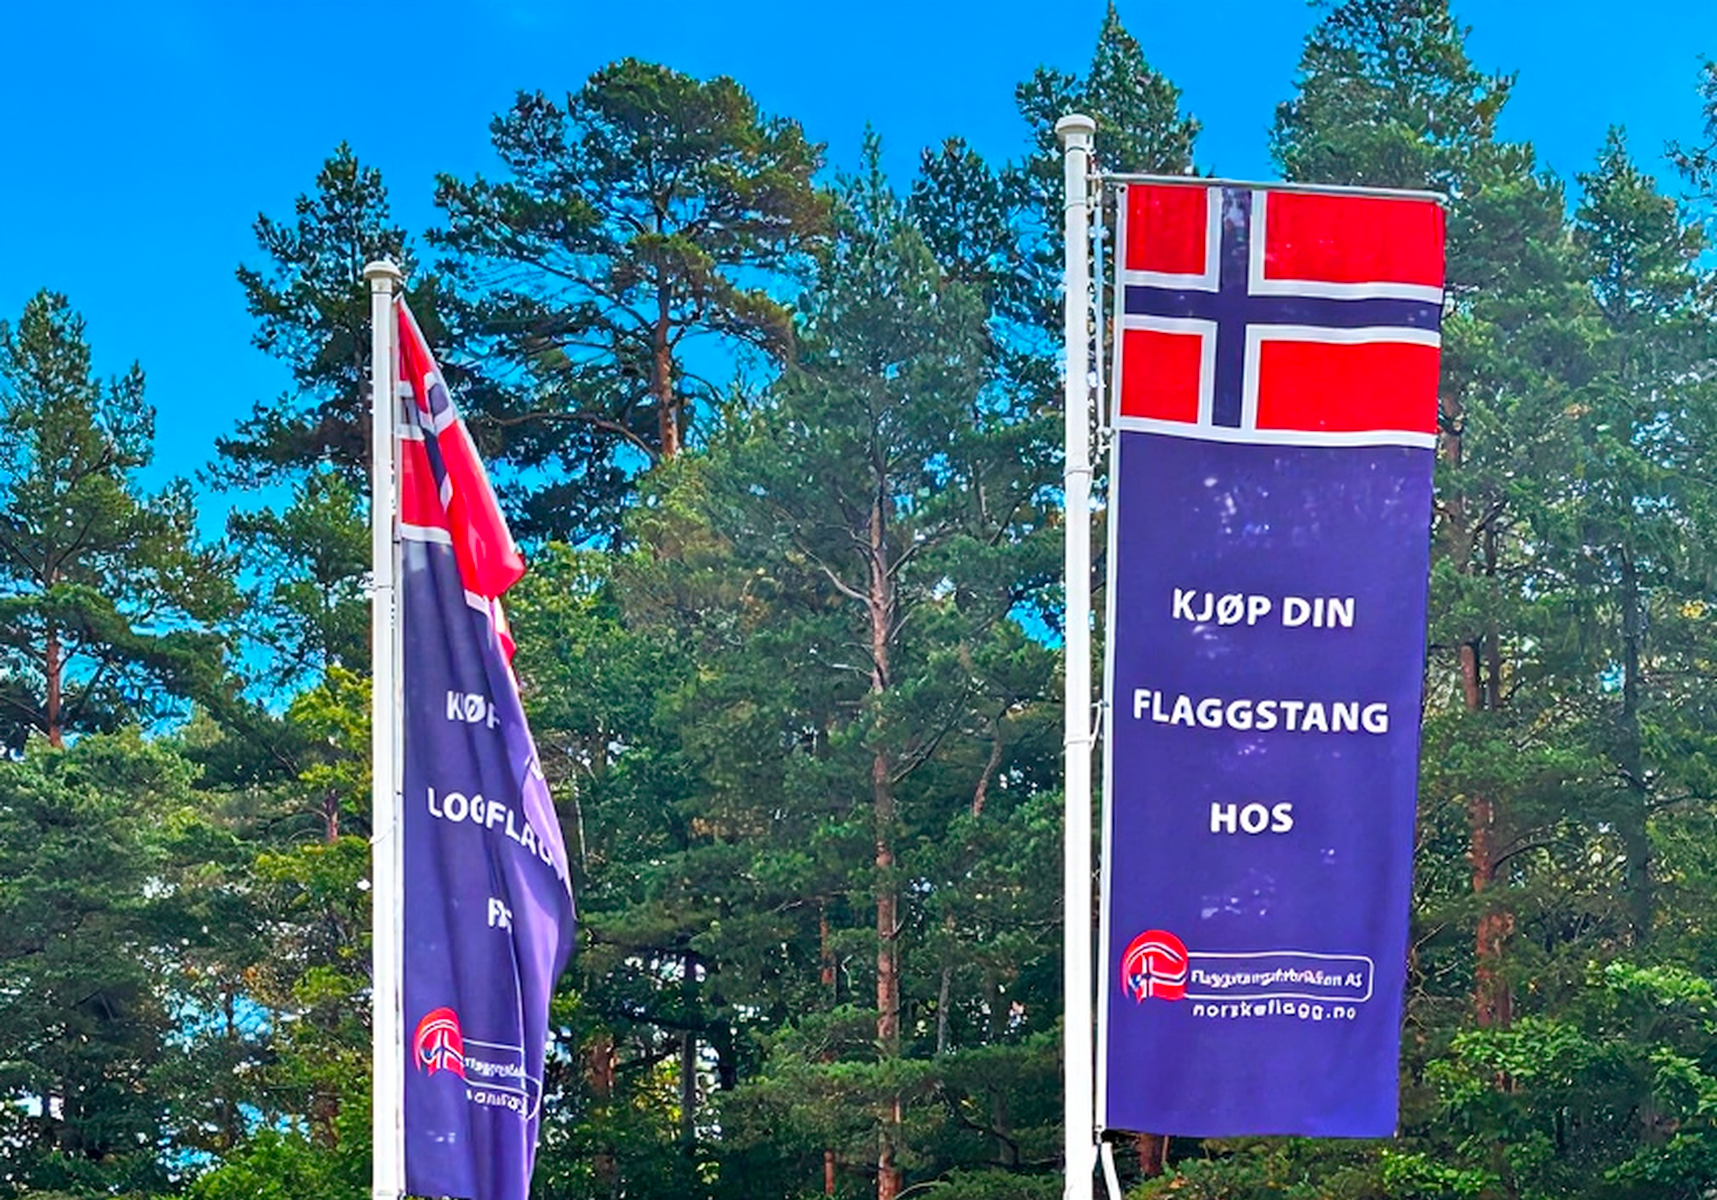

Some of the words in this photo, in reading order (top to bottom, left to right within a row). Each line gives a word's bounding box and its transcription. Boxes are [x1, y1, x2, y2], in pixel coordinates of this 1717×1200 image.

[1172, 587, 1272, 626] KJØP
[1281, 596, 1356, 629] DIN
[1132, 688, 1390, 734] FLAGGSTANG
[1209, 802, 1294, 834] HOS
